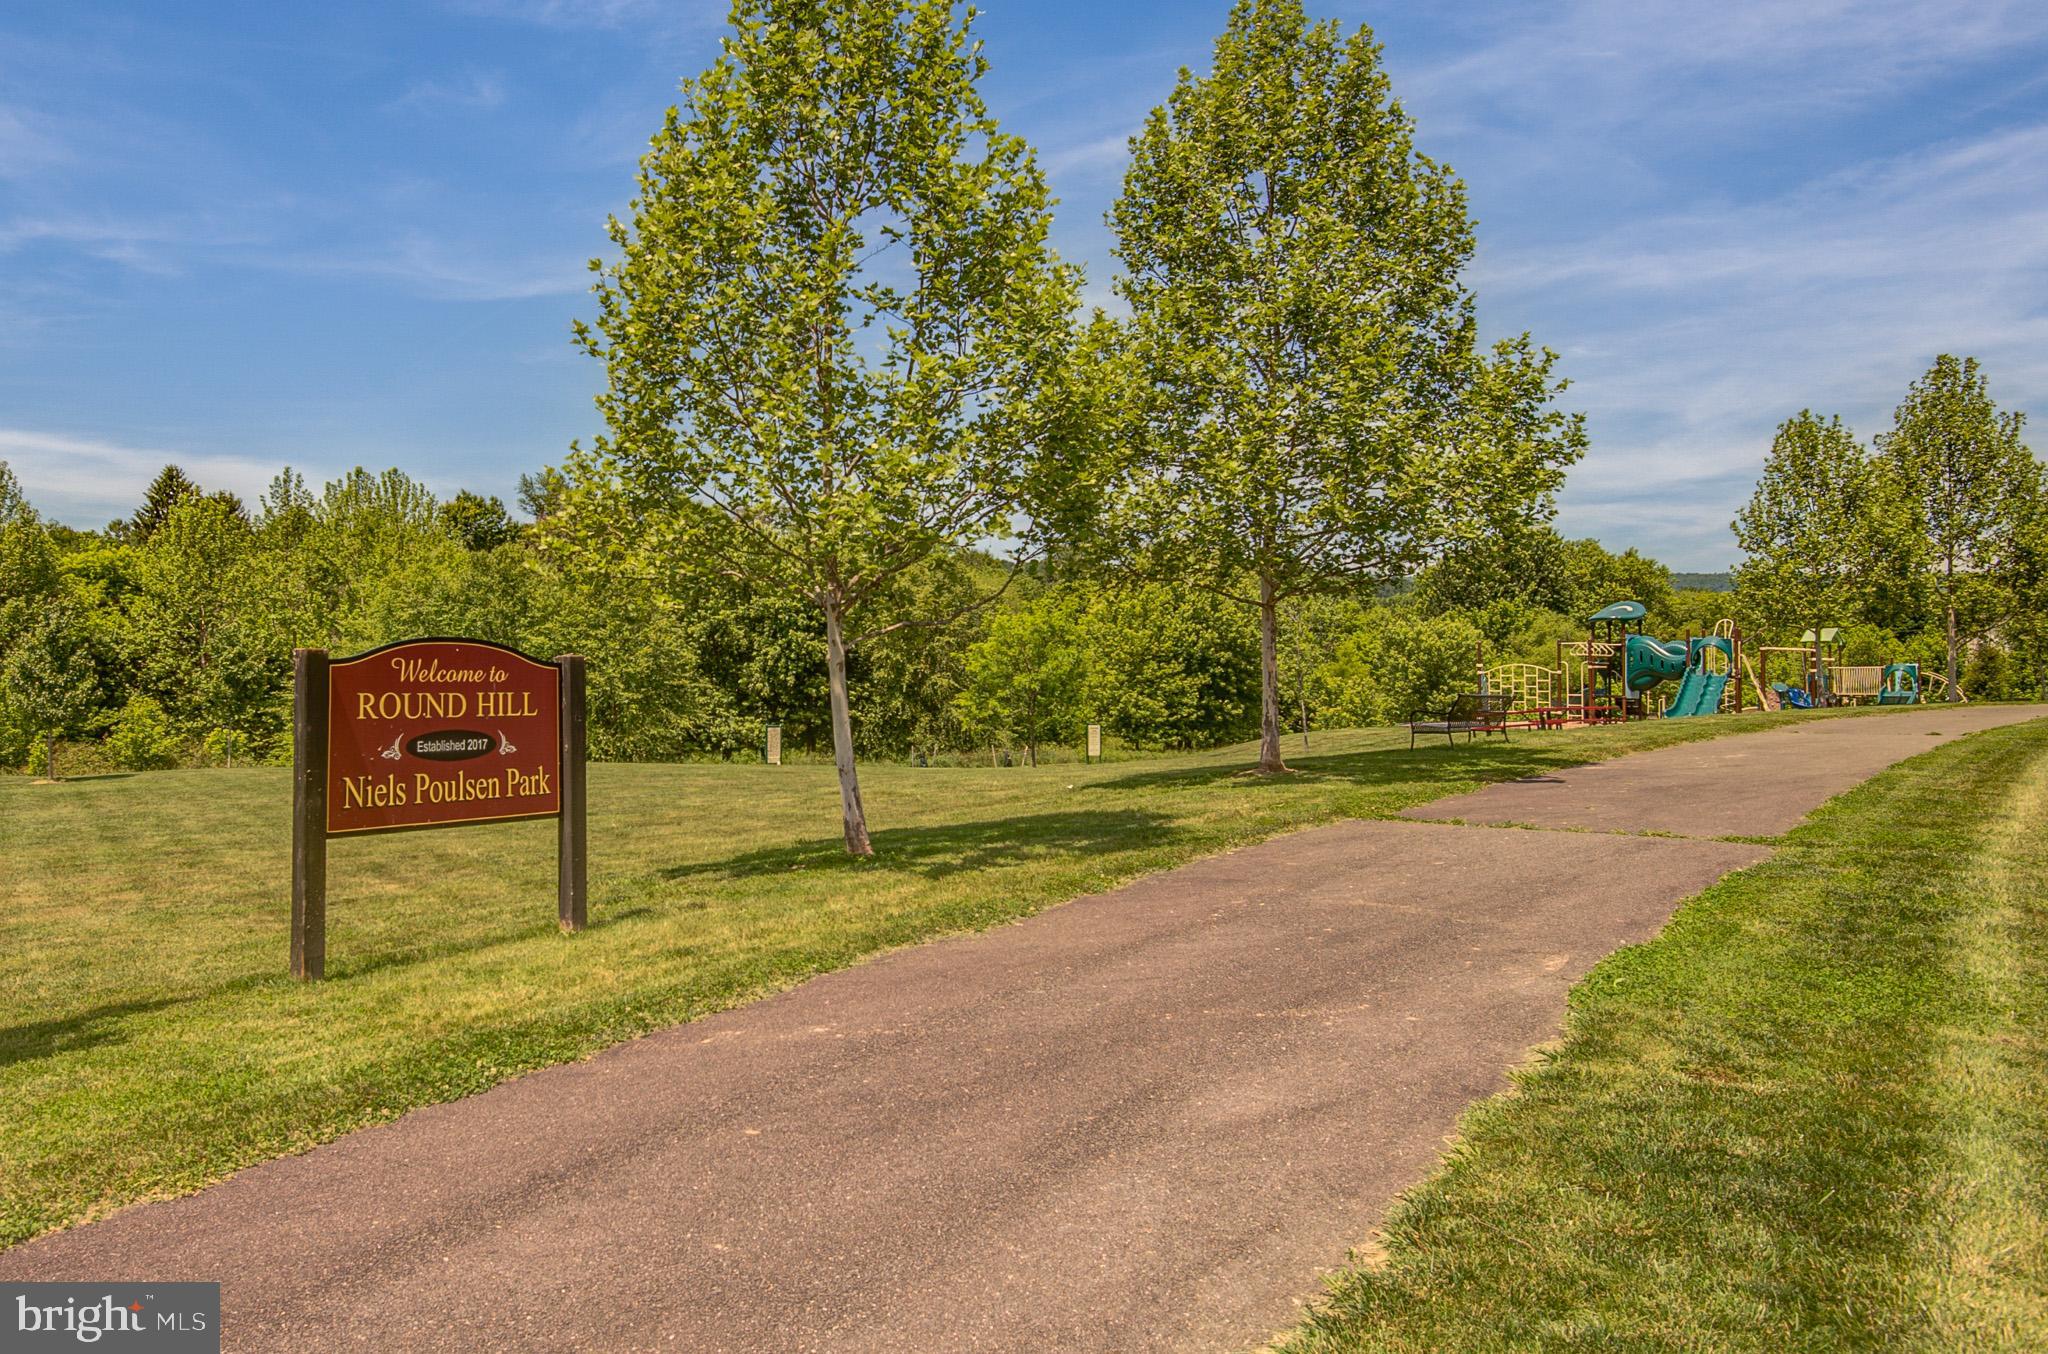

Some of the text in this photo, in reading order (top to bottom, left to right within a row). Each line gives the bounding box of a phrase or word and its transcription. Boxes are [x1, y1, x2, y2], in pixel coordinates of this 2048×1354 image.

[391, 657, 509, 683] Welcome to
[356, 692, 538, 720] ROUND HILL
[416, 738, 488, 753] Established 2017
[343, 765, 551, 809] Niels Poulsen Park
